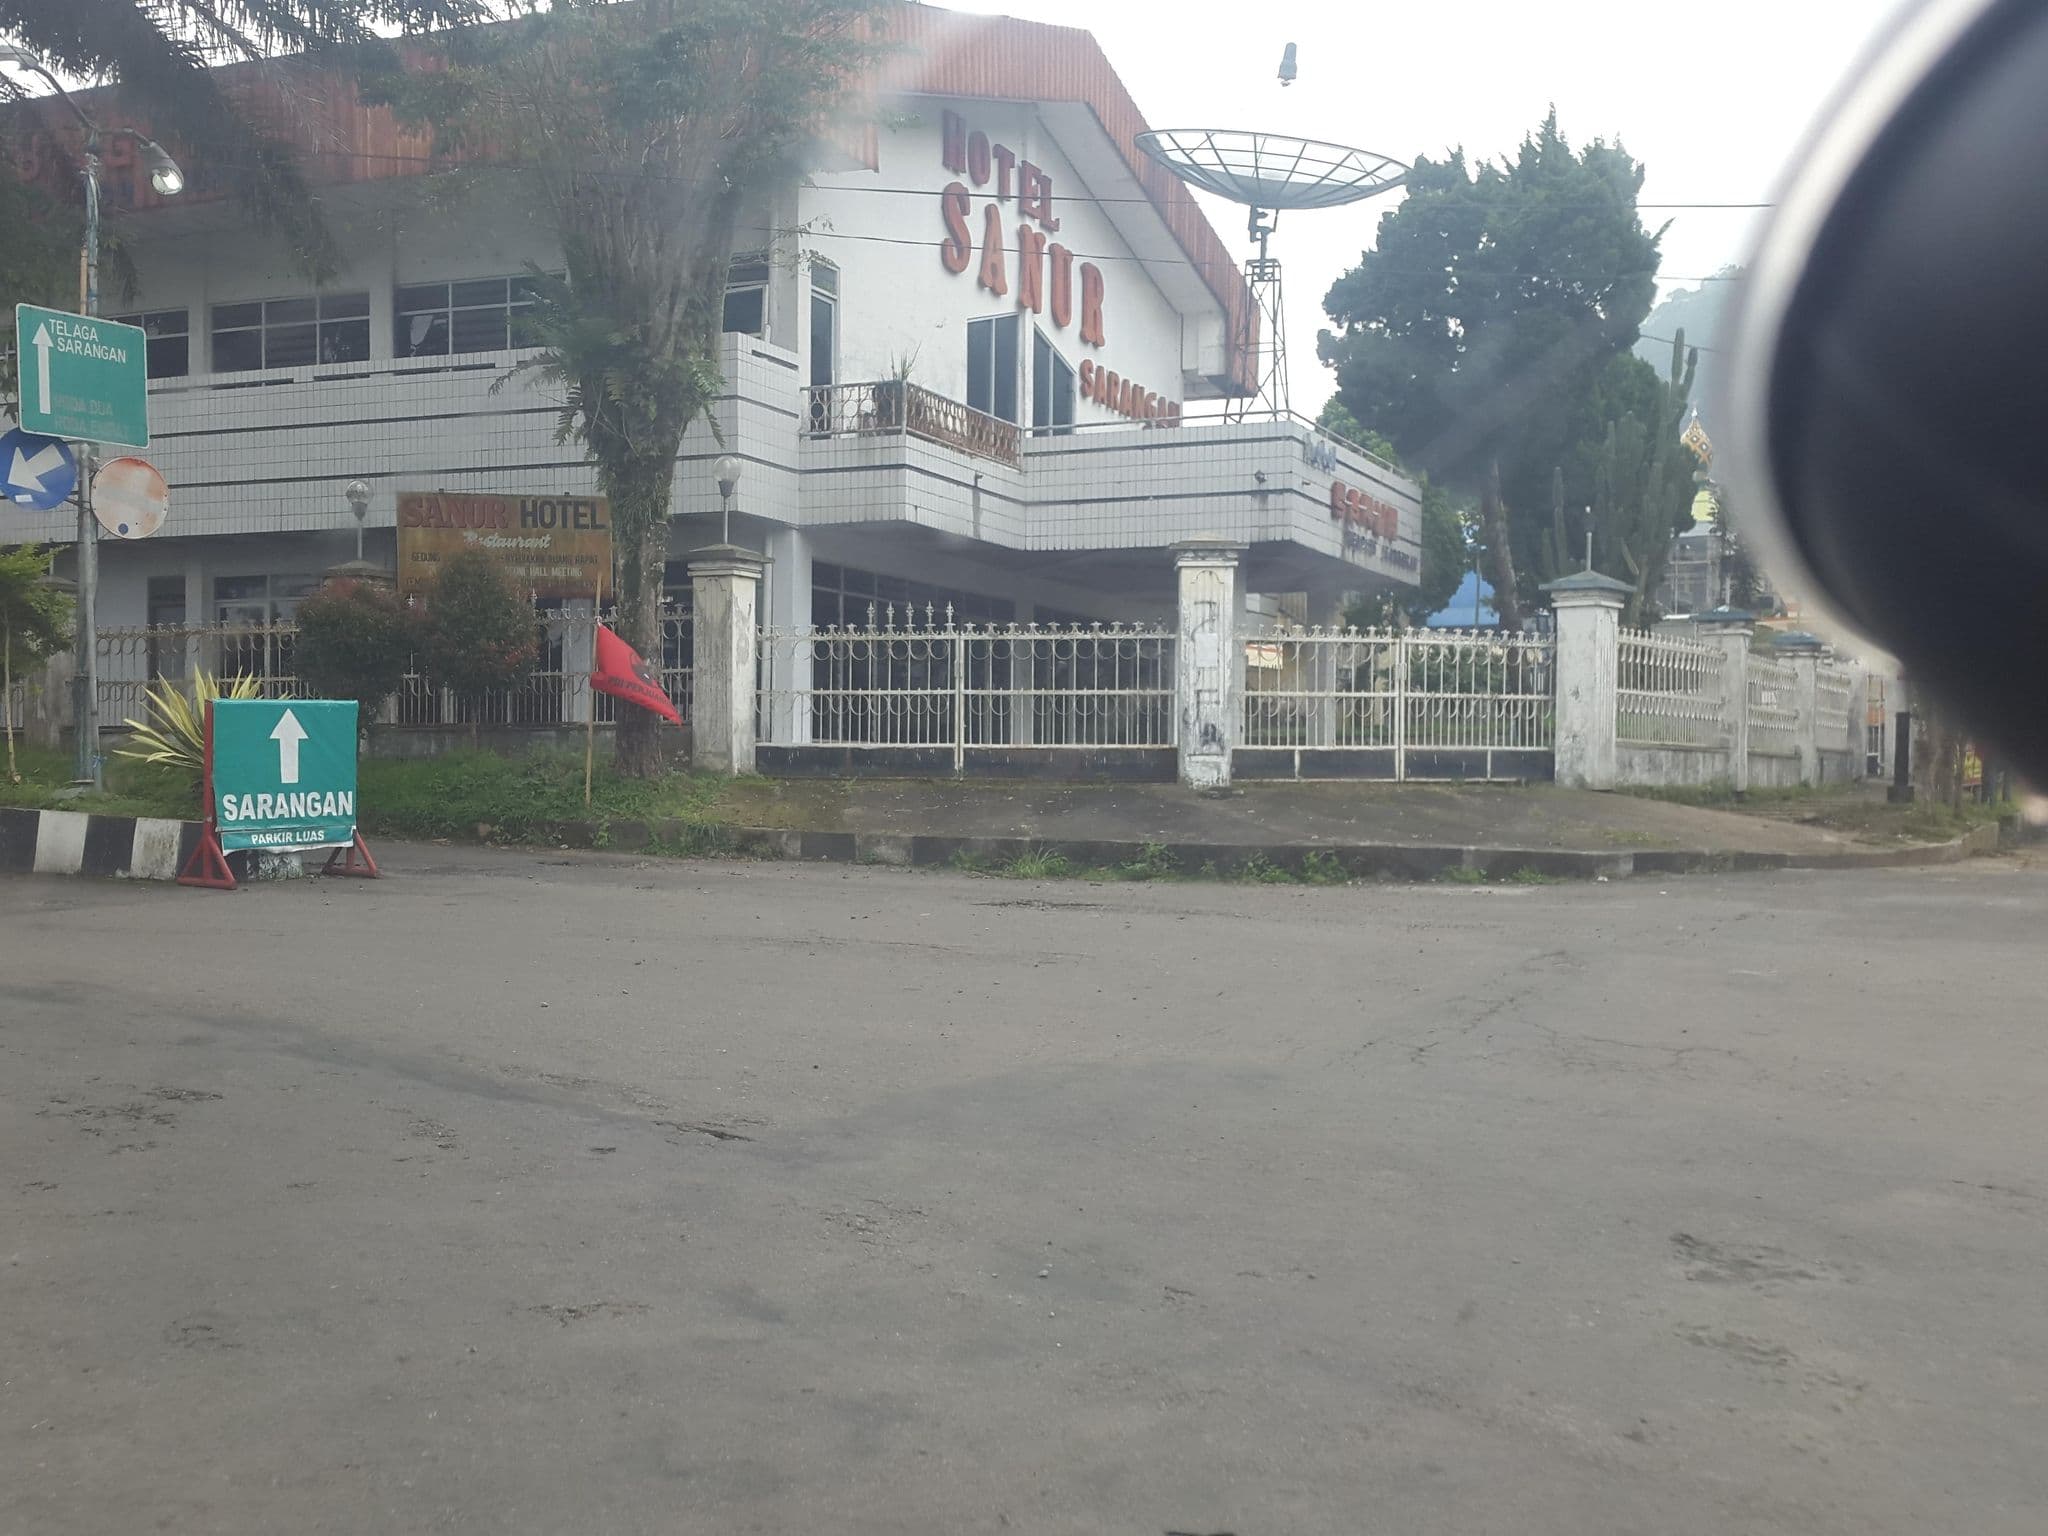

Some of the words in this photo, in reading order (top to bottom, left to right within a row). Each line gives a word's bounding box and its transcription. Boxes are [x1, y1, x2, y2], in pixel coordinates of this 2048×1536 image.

[942, 108, 1060, 232] HOTEL
[941, 181, 1105, 347] SANUR
[49, 319, 98, 342] TELAGA
[57, 337, 126, 364] SARANGAN
[403, 496, 509, 529] SANUR
[520, 499, 608, 530] HOTEL
[551, 566, 582, 577] MEETING
[222, 791, 353, 821] SARANGAN
[251, 830, 293, 845] PARKIR
[296, 829, 324, 842] LUAS
